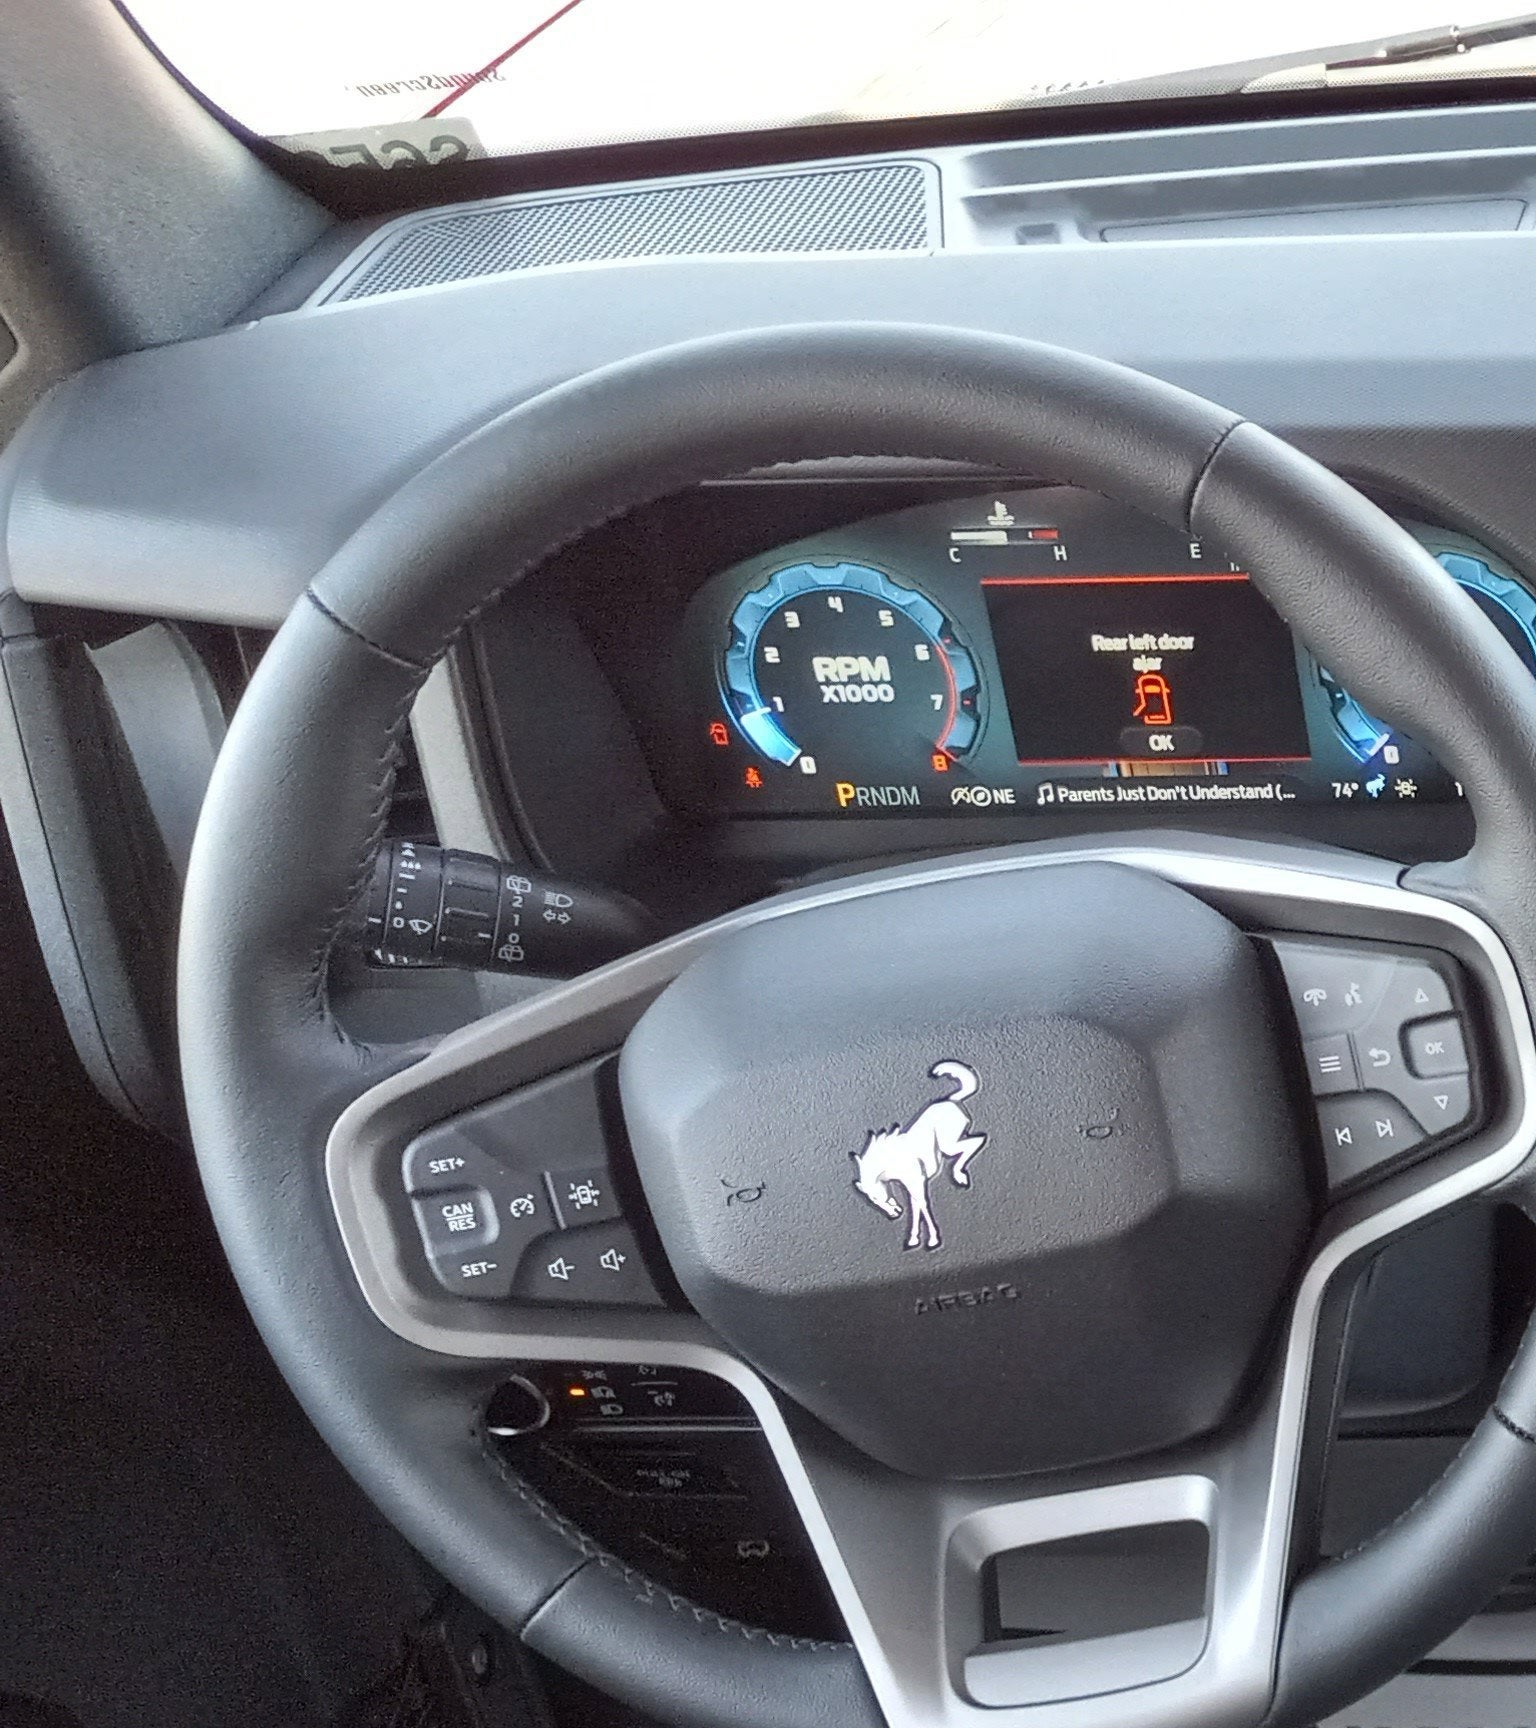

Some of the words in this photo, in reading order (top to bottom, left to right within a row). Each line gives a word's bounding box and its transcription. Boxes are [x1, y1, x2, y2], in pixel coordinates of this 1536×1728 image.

[950, 548, 961, 562] C
[1055, 546, 1067, 561] H
[1190, 543, 1202, 559] E
[828, 597, 843, 613] 4
[785, 612, 800, 628] 3
[879, 610, 894, 627] 5
[1091, 634, 1128, 652] Rear
[1128, 633, 1157, 650] left
[1157, 633, 1195, 650] door
[764, 647, 780, 664] 2
[915, 644, 930, 660] 6
[813, 656, 891, 682] RPM
[1132, 654, 1162, 674] ajar
[822, 684, 895, 703] X1000
[773, 697, 785, 712] 1
[931, 694, 943, 710] 7
[1149, 734, 1175, 751] OK
[800, 756, 816, 774] 0
[932, 754, 948, 771] 8
[994, 788, 1016, 803] NE
[1058, 786, 1113, 803] Parents
[1117, 784, 1150, 801] Just
[1153, 783, 1186, 800] Don't
[1189, 782, 1272, 800] Understand
[1331, 781, 1359, 798] 74°
[1425, 1041, 1445, 1055] OK
[429, 1157, 466, 1174] SET+
[442, 1202, 474, 1218] CAN
[449, 1219, 476, 1232] RES
